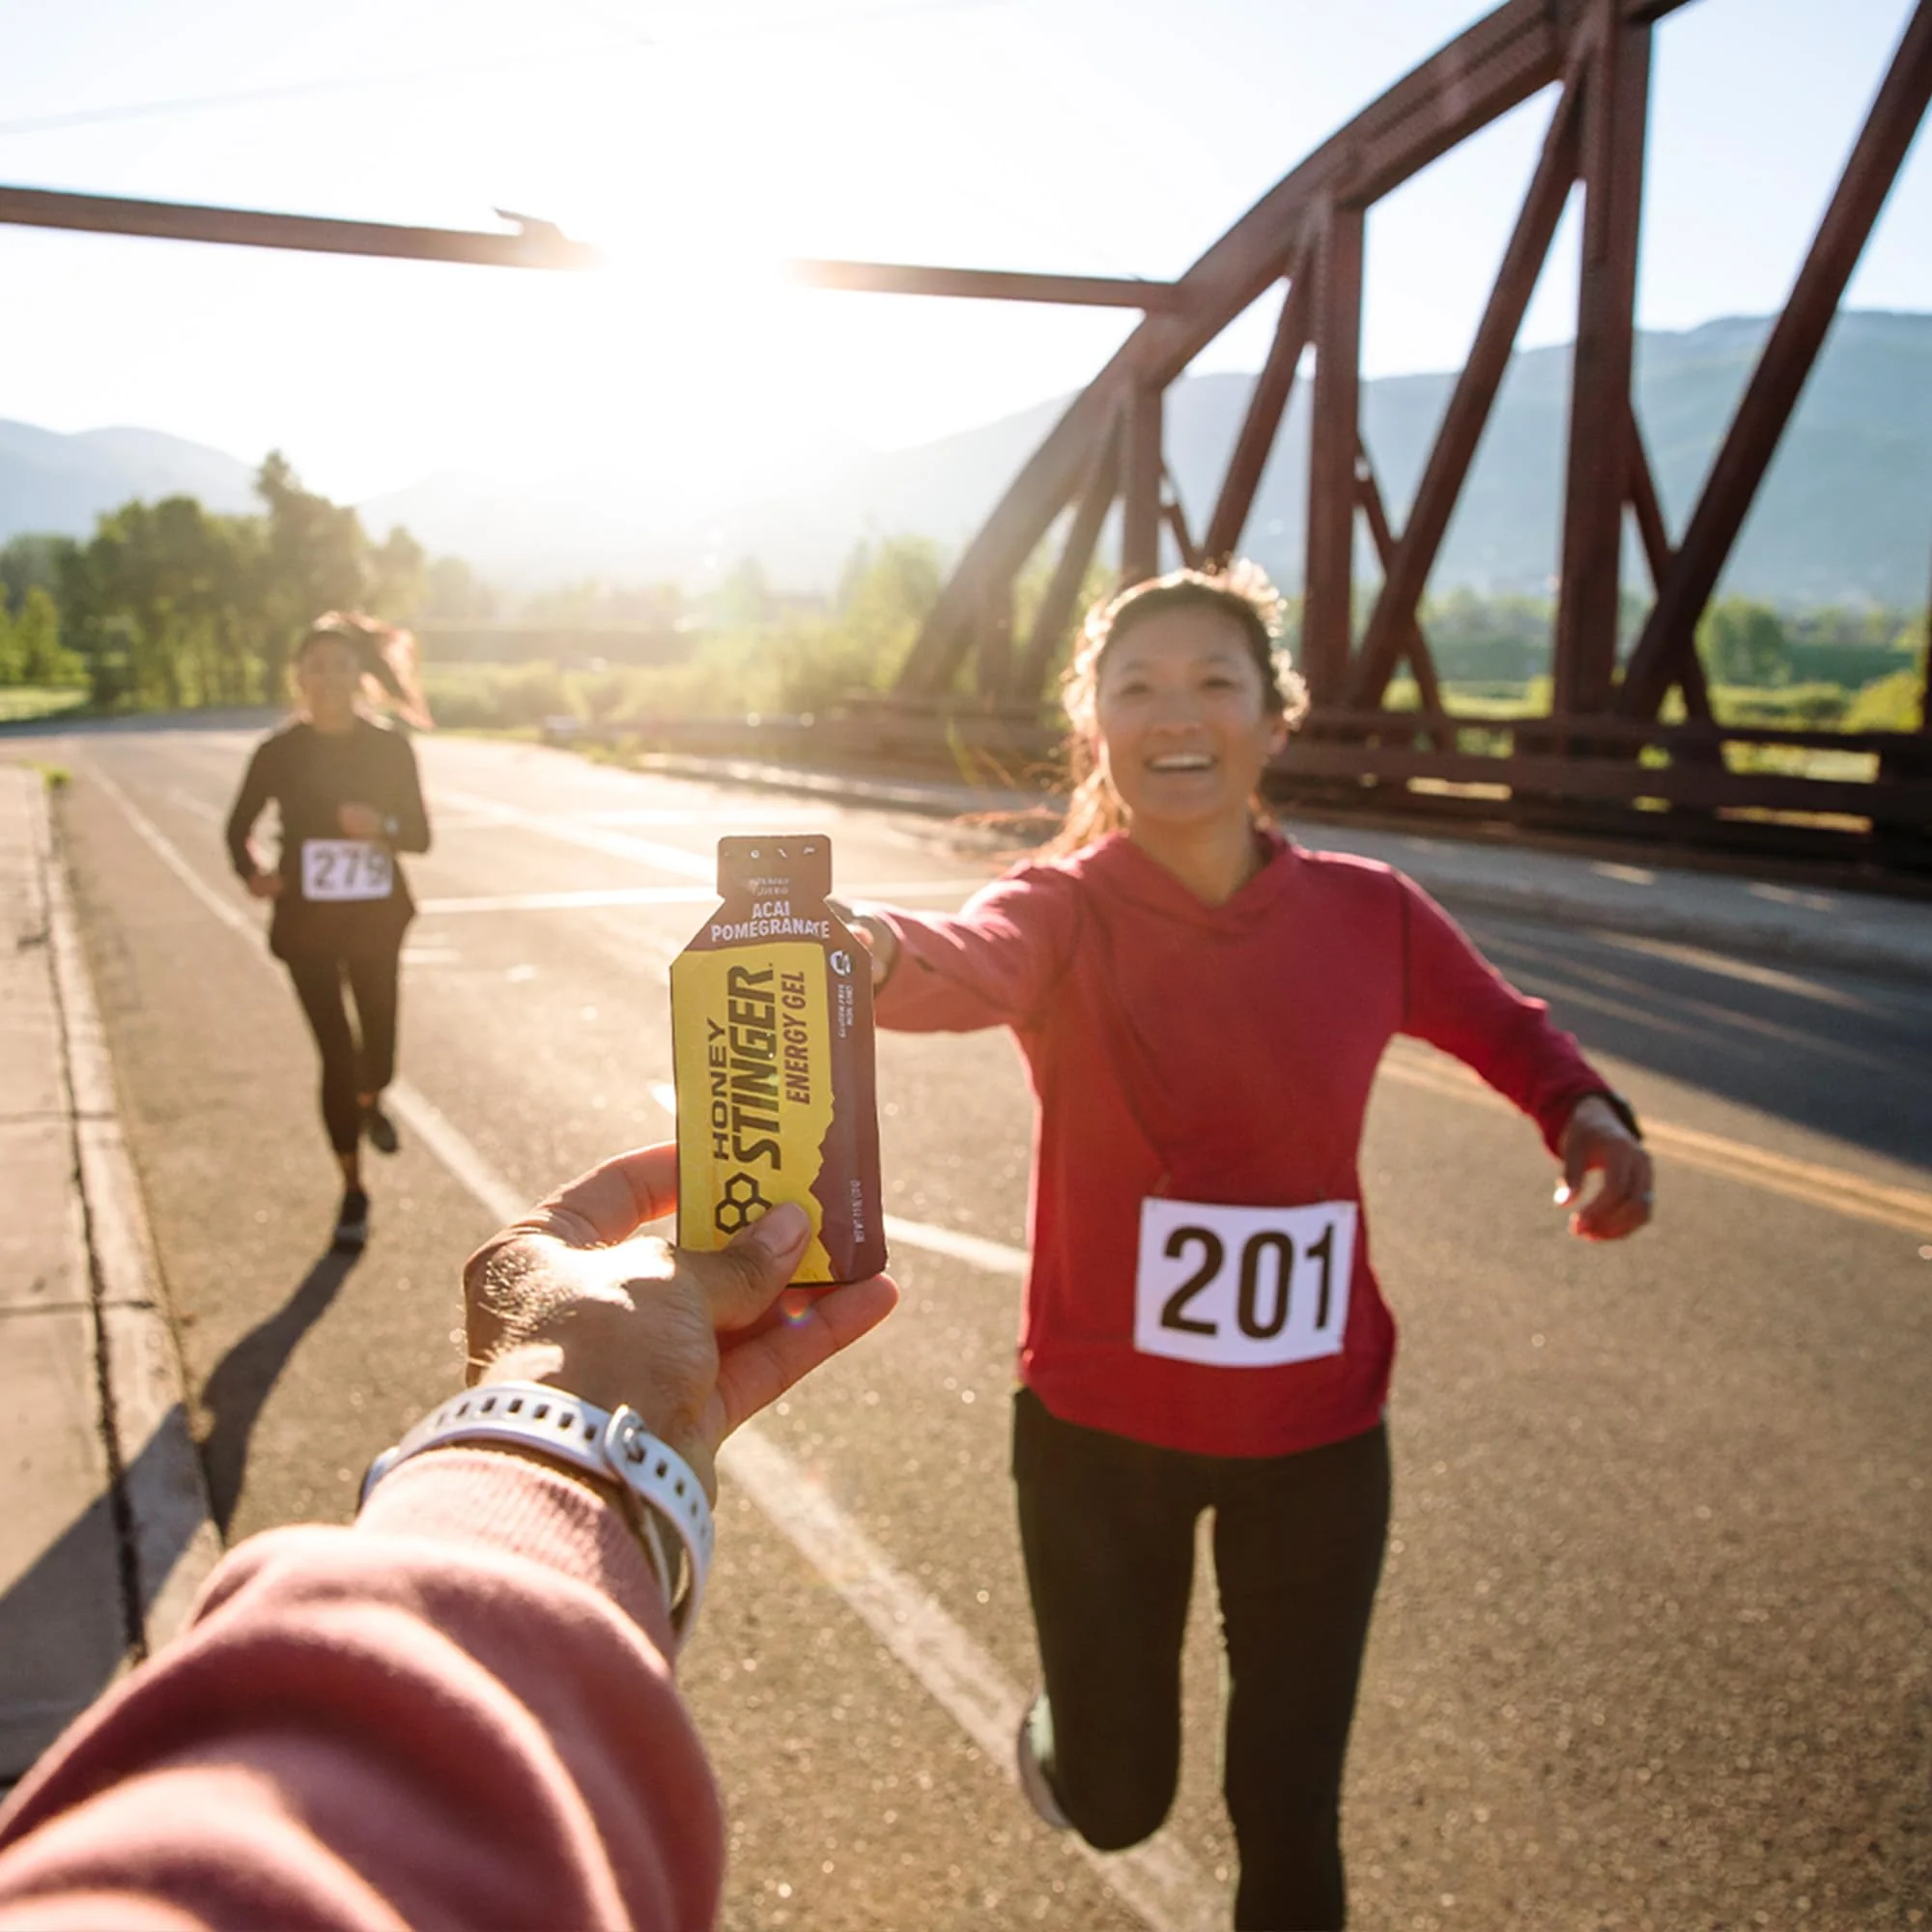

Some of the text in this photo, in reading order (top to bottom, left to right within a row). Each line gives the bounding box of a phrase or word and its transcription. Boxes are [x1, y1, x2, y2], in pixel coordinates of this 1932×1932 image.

[710, 920, 831, 942] POMEGRANATE
[752, 900, 791, 920] ACAI
[707, 1017, 729, 1161] HONEY
[727, 964, 781, 1171] STINGER
[781, 971, 810, 1105] ENERGY GEL
[1160, 1222, 1335, 1341] 201
